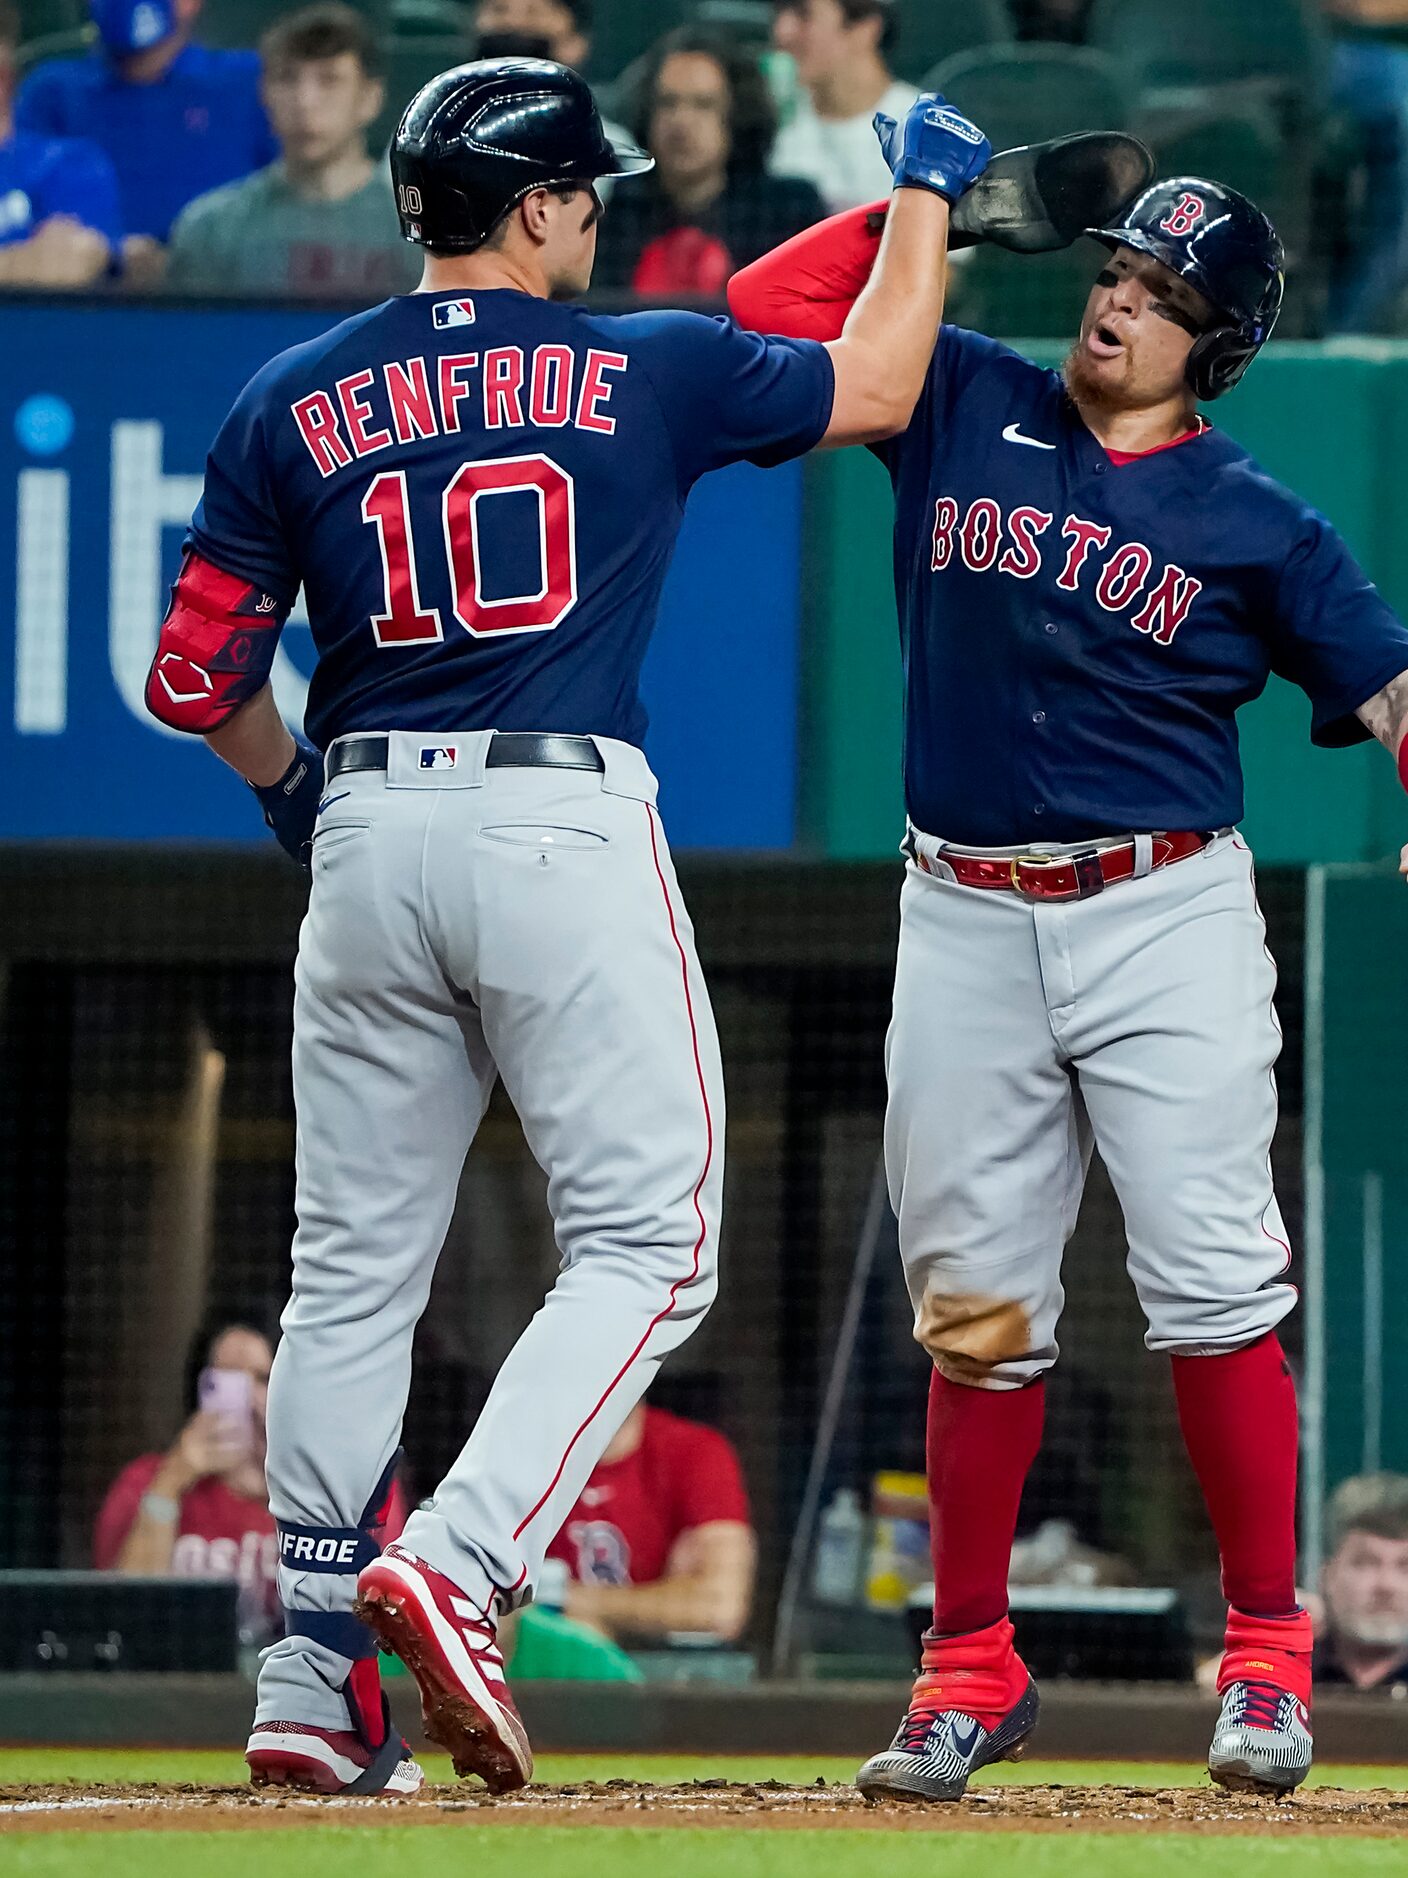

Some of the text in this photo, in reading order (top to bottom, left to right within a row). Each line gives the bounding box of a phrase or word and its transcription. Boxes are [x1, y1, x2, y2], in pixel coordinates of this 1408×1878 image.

[398, 184, 423, 215] 10
[1160, 191, 1205, 236] B
[290, 344, 628, 478] RENFROE
[360, 452, 578, 648] 10
[931, 496, 1203, 645] BOSTON
